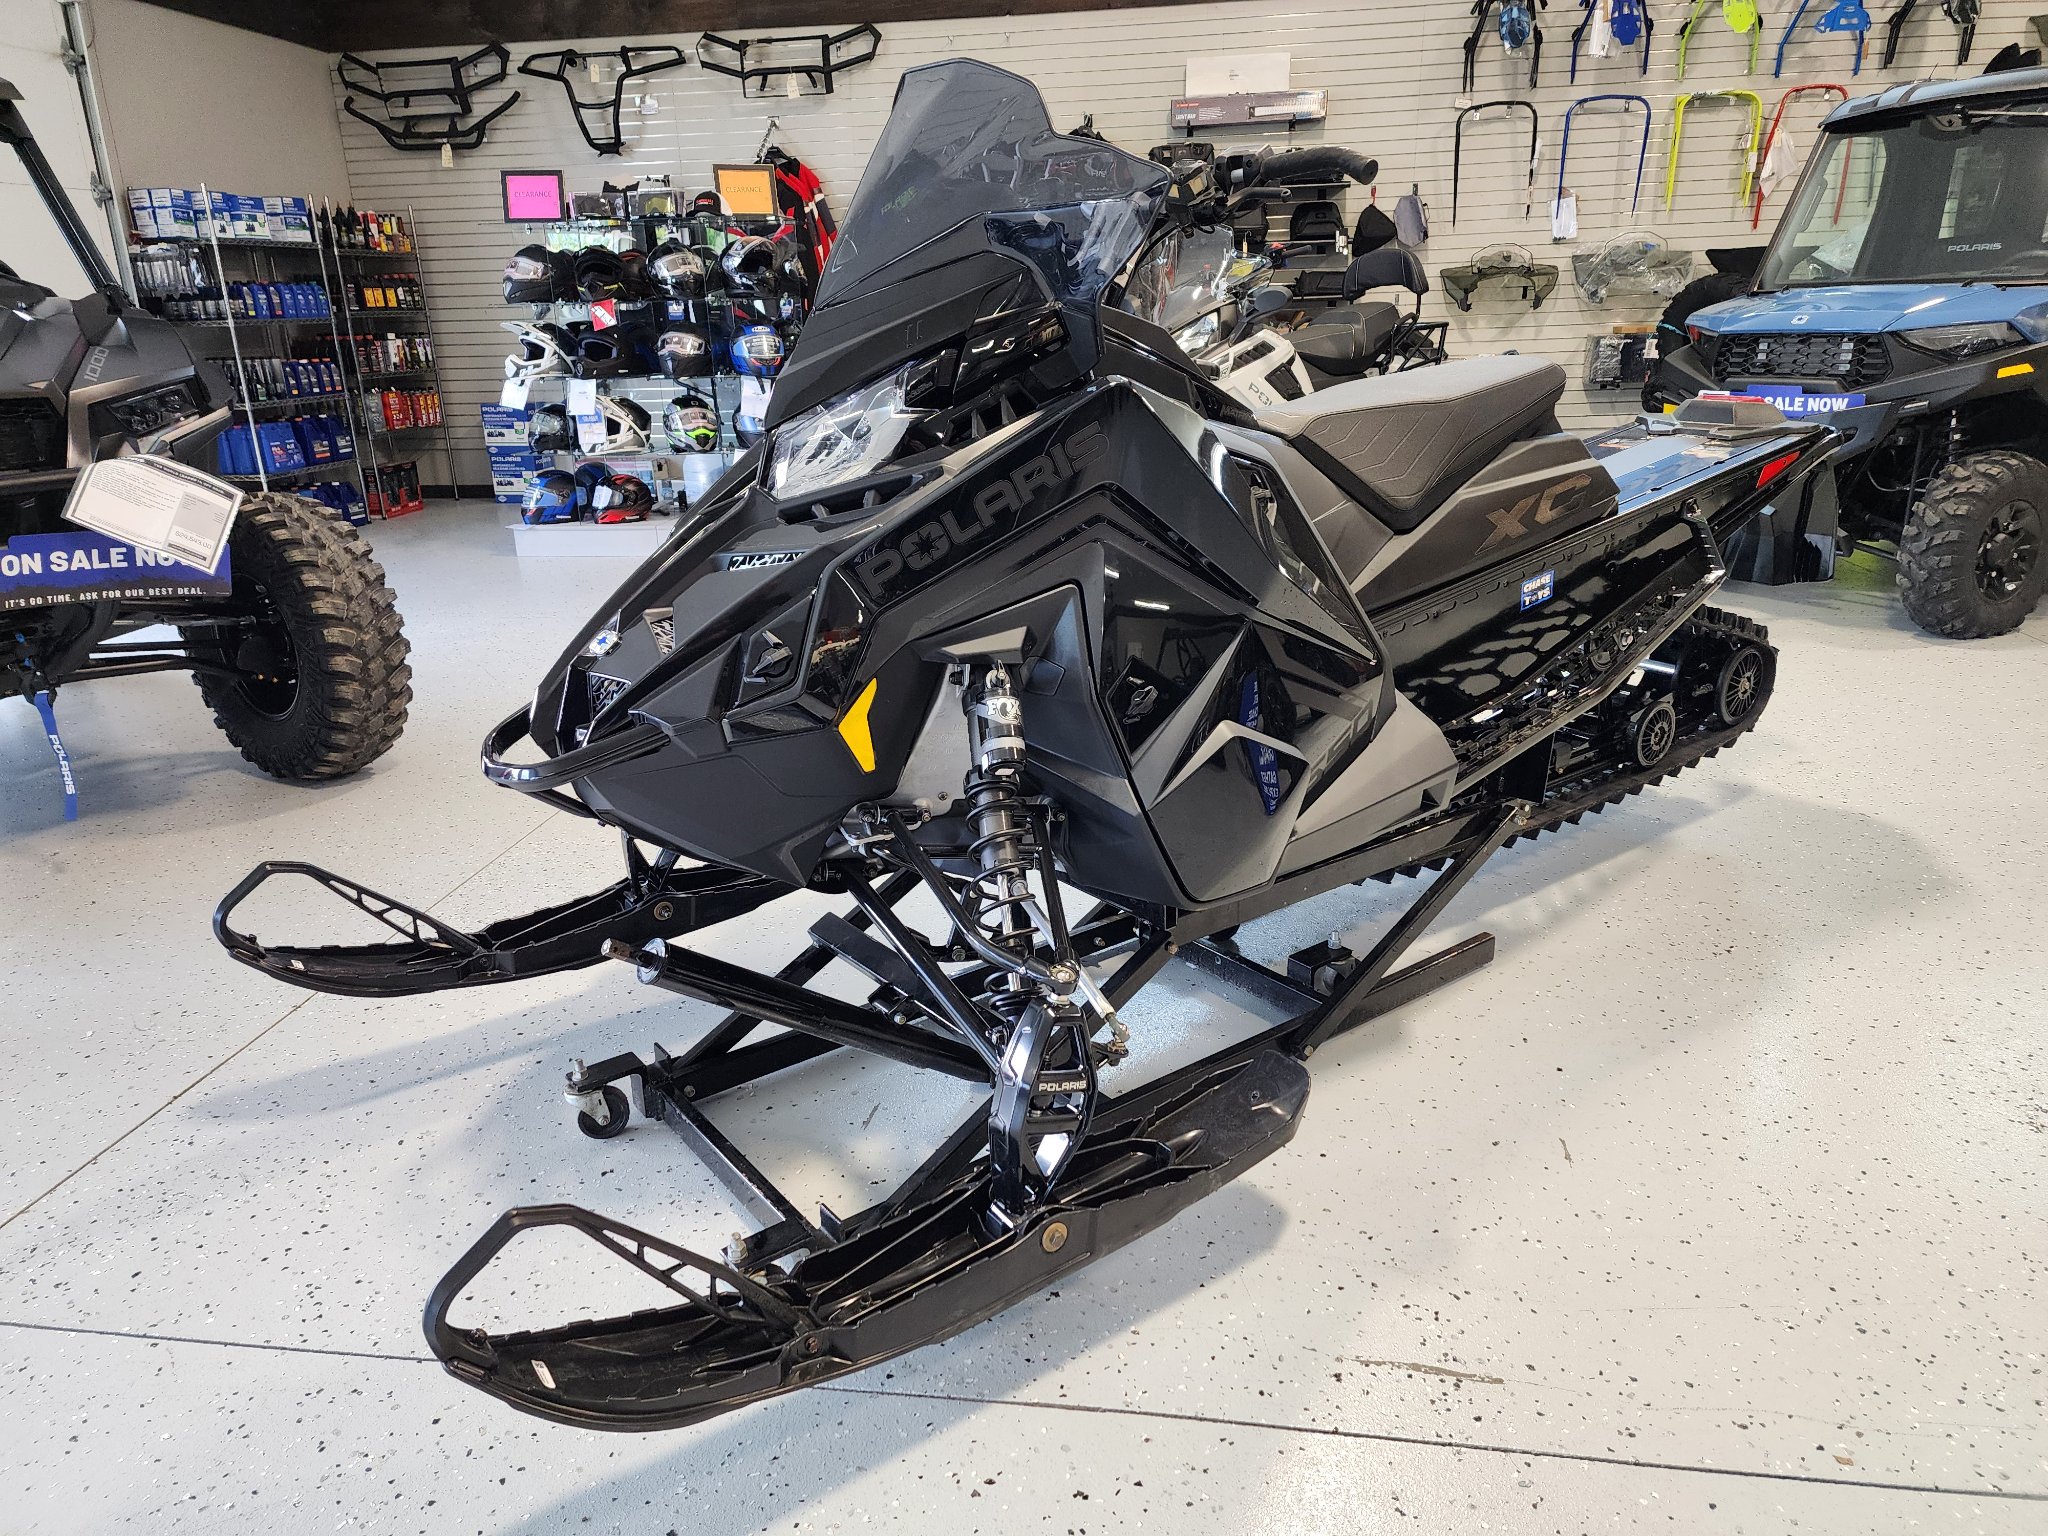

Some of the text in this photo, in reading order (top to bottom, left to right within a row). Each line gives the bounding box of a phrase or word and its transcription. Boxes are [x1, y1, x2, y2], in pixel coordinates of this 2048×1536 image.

[514, 190, 552, 198] CLEARANCE
[725, 186, 763, 194] CLEARANCE
[1947, 242, 2002, 252] POLARIS
[84, 346, 109, 381] 1000
[1807, 397, 1849, 412] NOW
[855, 420, 1110, 599] POLARIS
[1475, 474, 1592, 556] XC
[1, 553, 42, 576] ON
[50, 547, 128, 571] SALE
[135, 547, 190, 566] NO
[1523, 573, 1552, 593] CHASE
[5, 586, 207, 609] IT'S GO TIME. ASK FOR OUR BEST DEAL.
[986, 698, 1021, 720] FOX
[48, 735, 76, 794] POLARIS
[1038, 1080, 1086, 1092] POLARIS
